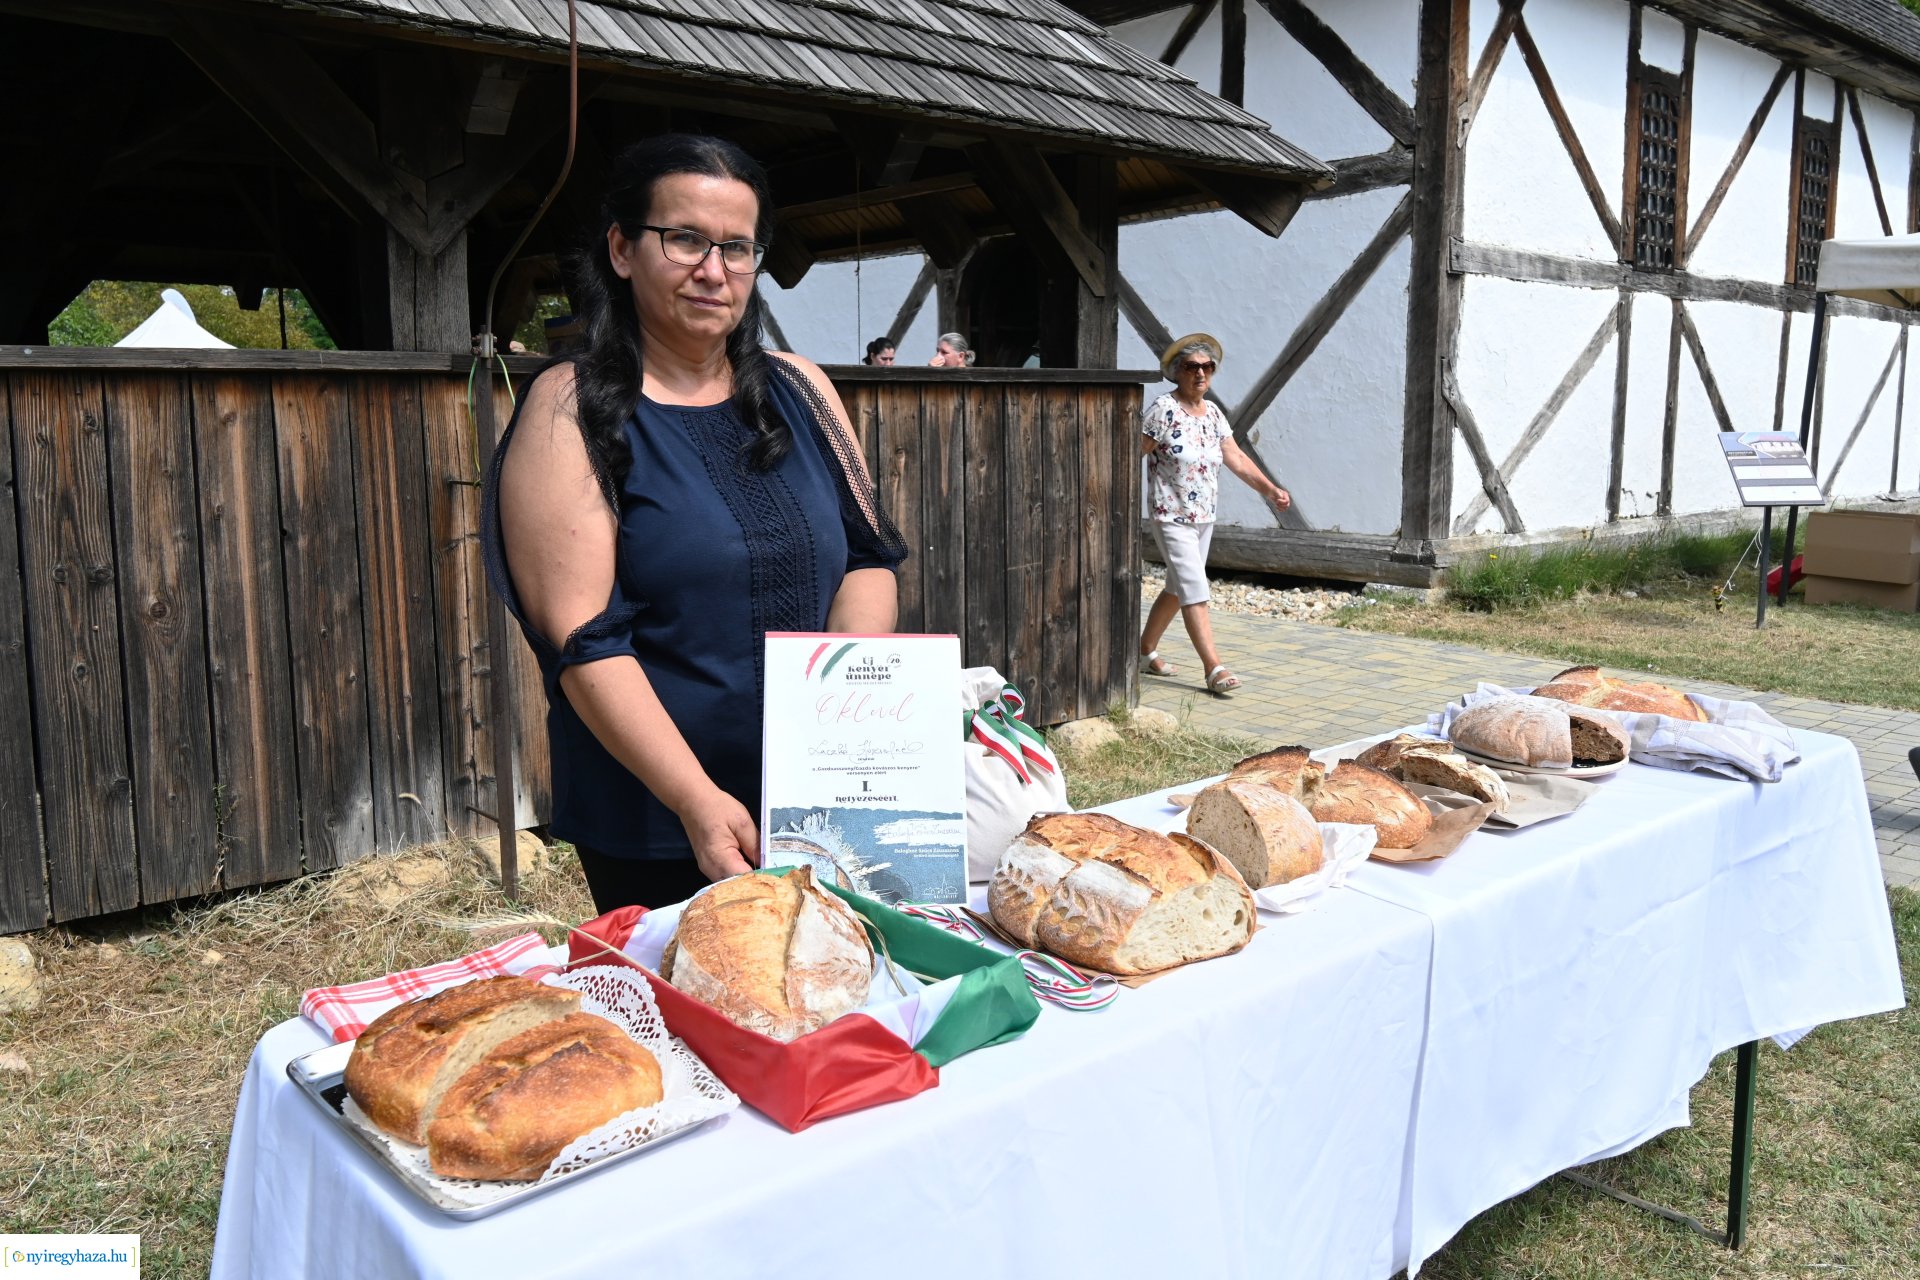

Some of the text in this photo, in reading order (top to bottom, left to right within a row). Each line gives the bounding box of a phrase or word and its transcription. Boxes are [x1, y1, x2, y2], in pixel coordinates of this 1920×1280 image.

[845, 672, 892, 681] ünnepe
[816, 690, 914, 725] Oklevél
[862, 780, 872, 792] I.
